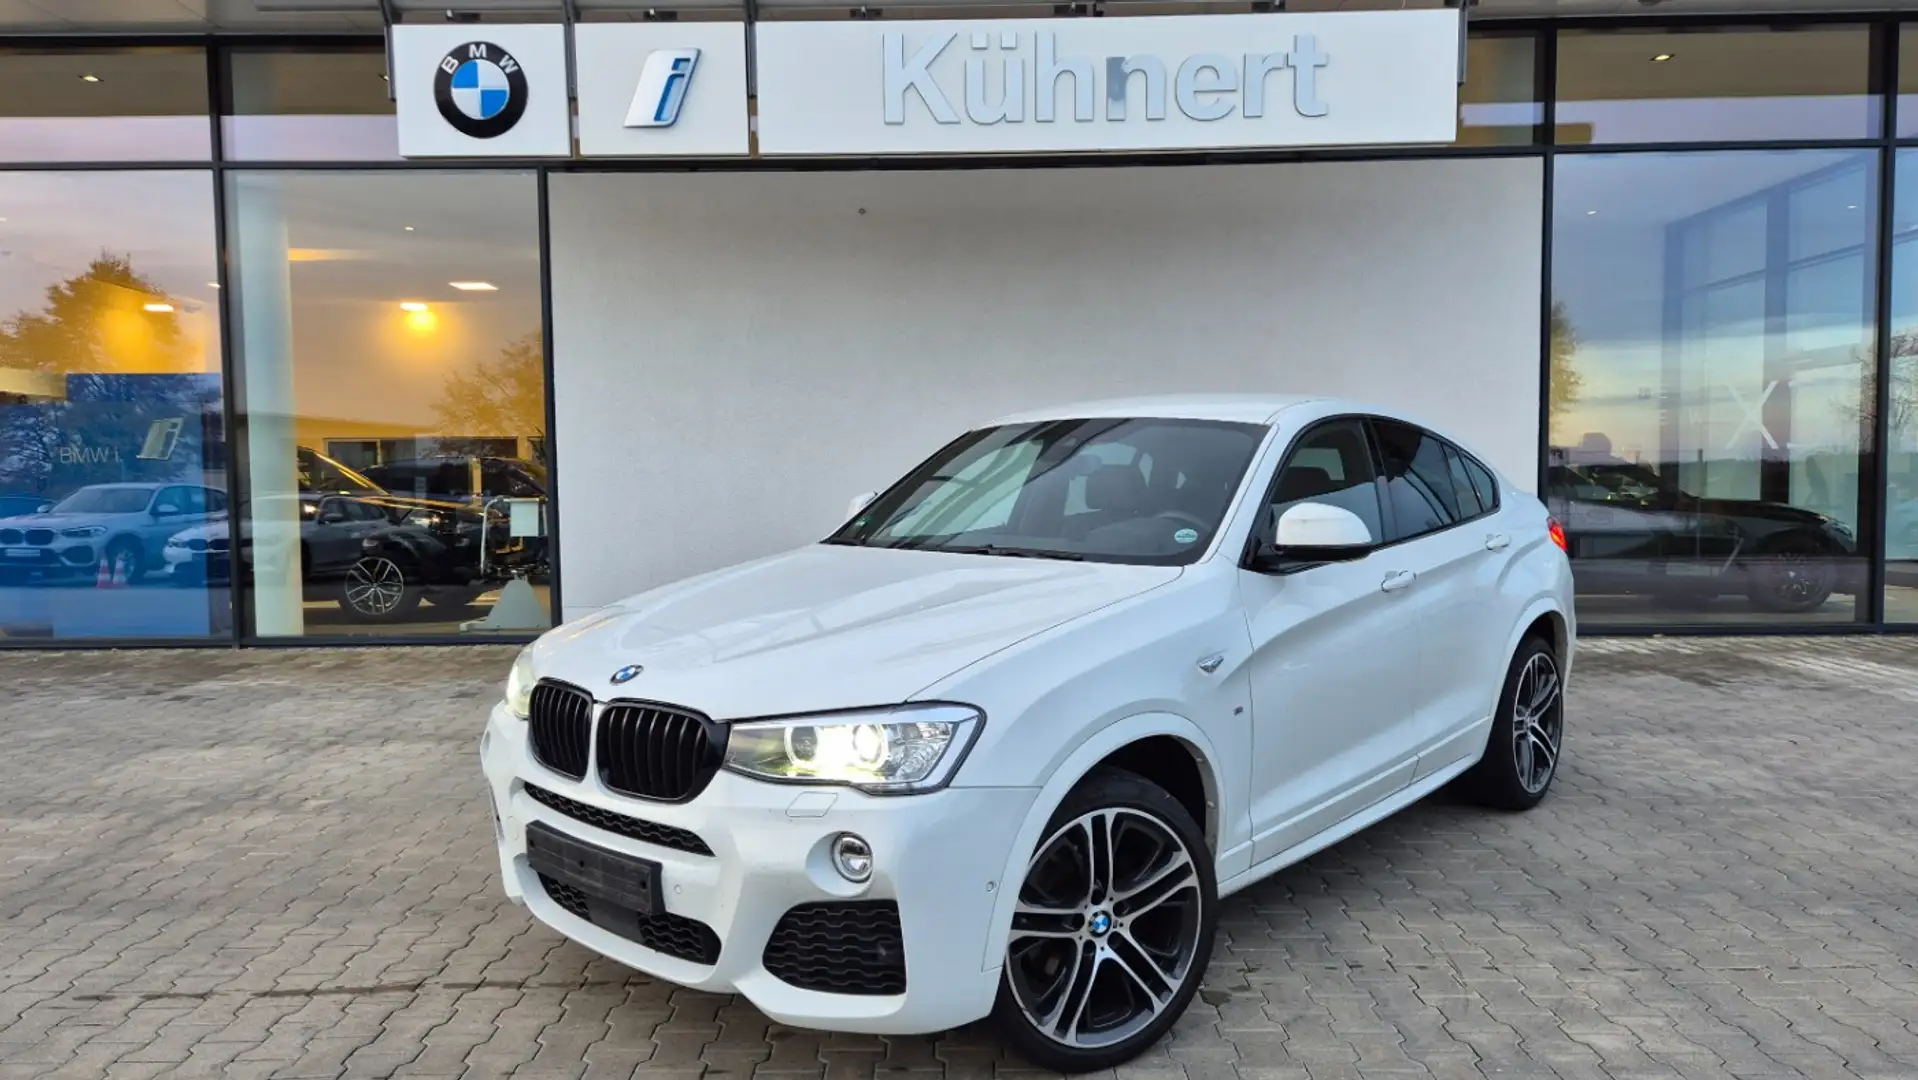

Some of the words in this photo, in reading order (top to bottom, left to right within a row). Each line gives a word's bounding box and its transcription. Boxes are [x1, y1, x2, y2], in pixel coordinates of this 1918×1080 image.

[440, 43, 519, 75] BMW
[882, 31, 1329, 125] Kühnert
[60, 447, 109, 464] BMW
